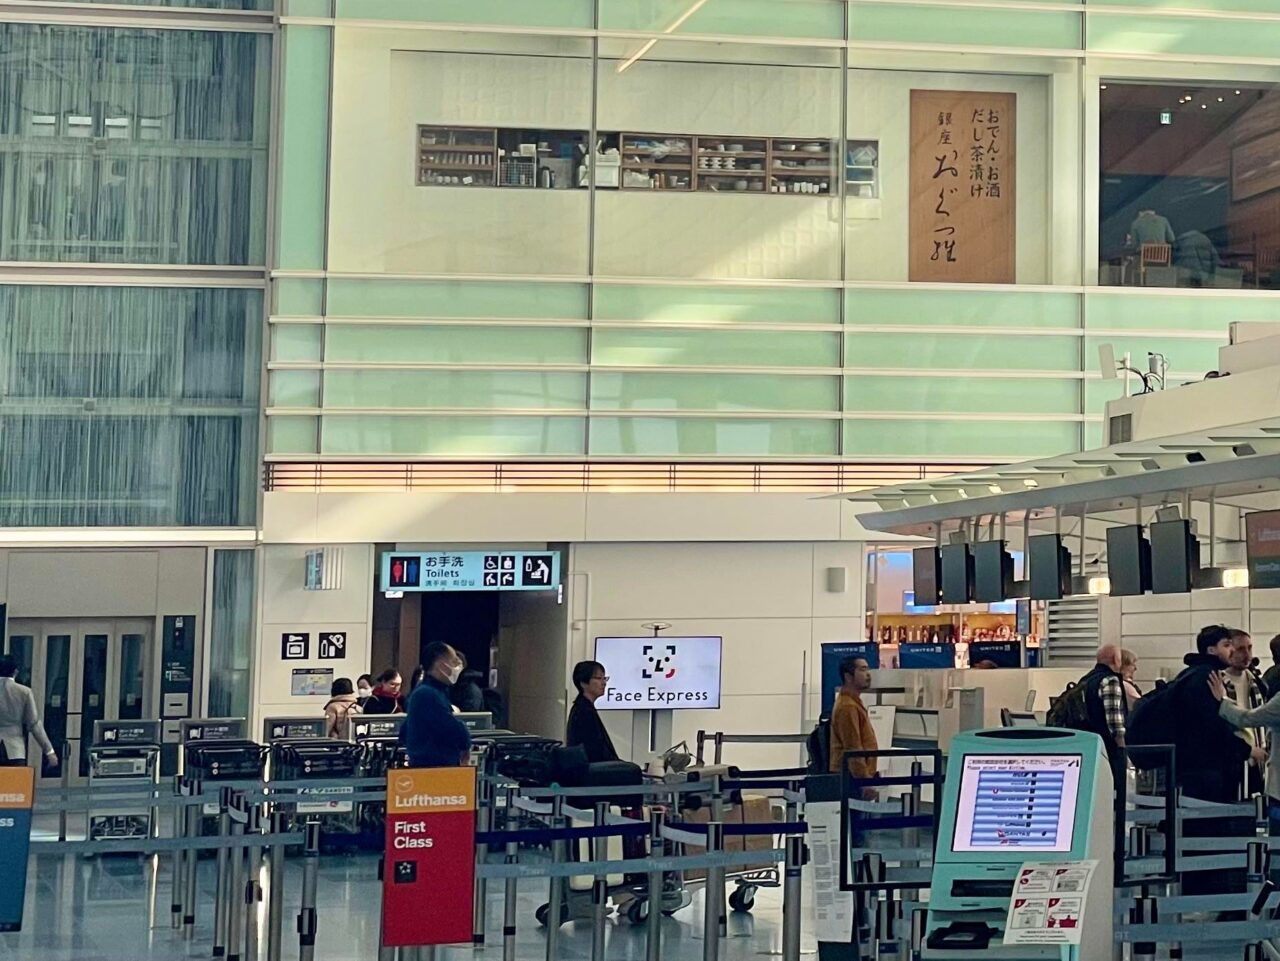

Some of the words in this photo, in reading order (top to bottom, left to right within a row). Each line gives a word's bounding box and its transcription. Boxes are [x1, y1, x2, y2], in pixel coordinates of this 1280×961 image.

[969, 108, 985, 198] だし茶漬け
[986, 108, 1000, 198] おでん・お酒
[425, 556, 464, 568] お手洗
[425, 569, 459, 578] Toilets
[607, 687, 642, 702] Face
[648, 687, 708, 705] Express
[395, 794, 467, 808] Lufthansa
[394, 821, 426, 834] First
[393, 837, 434, 849] Class
